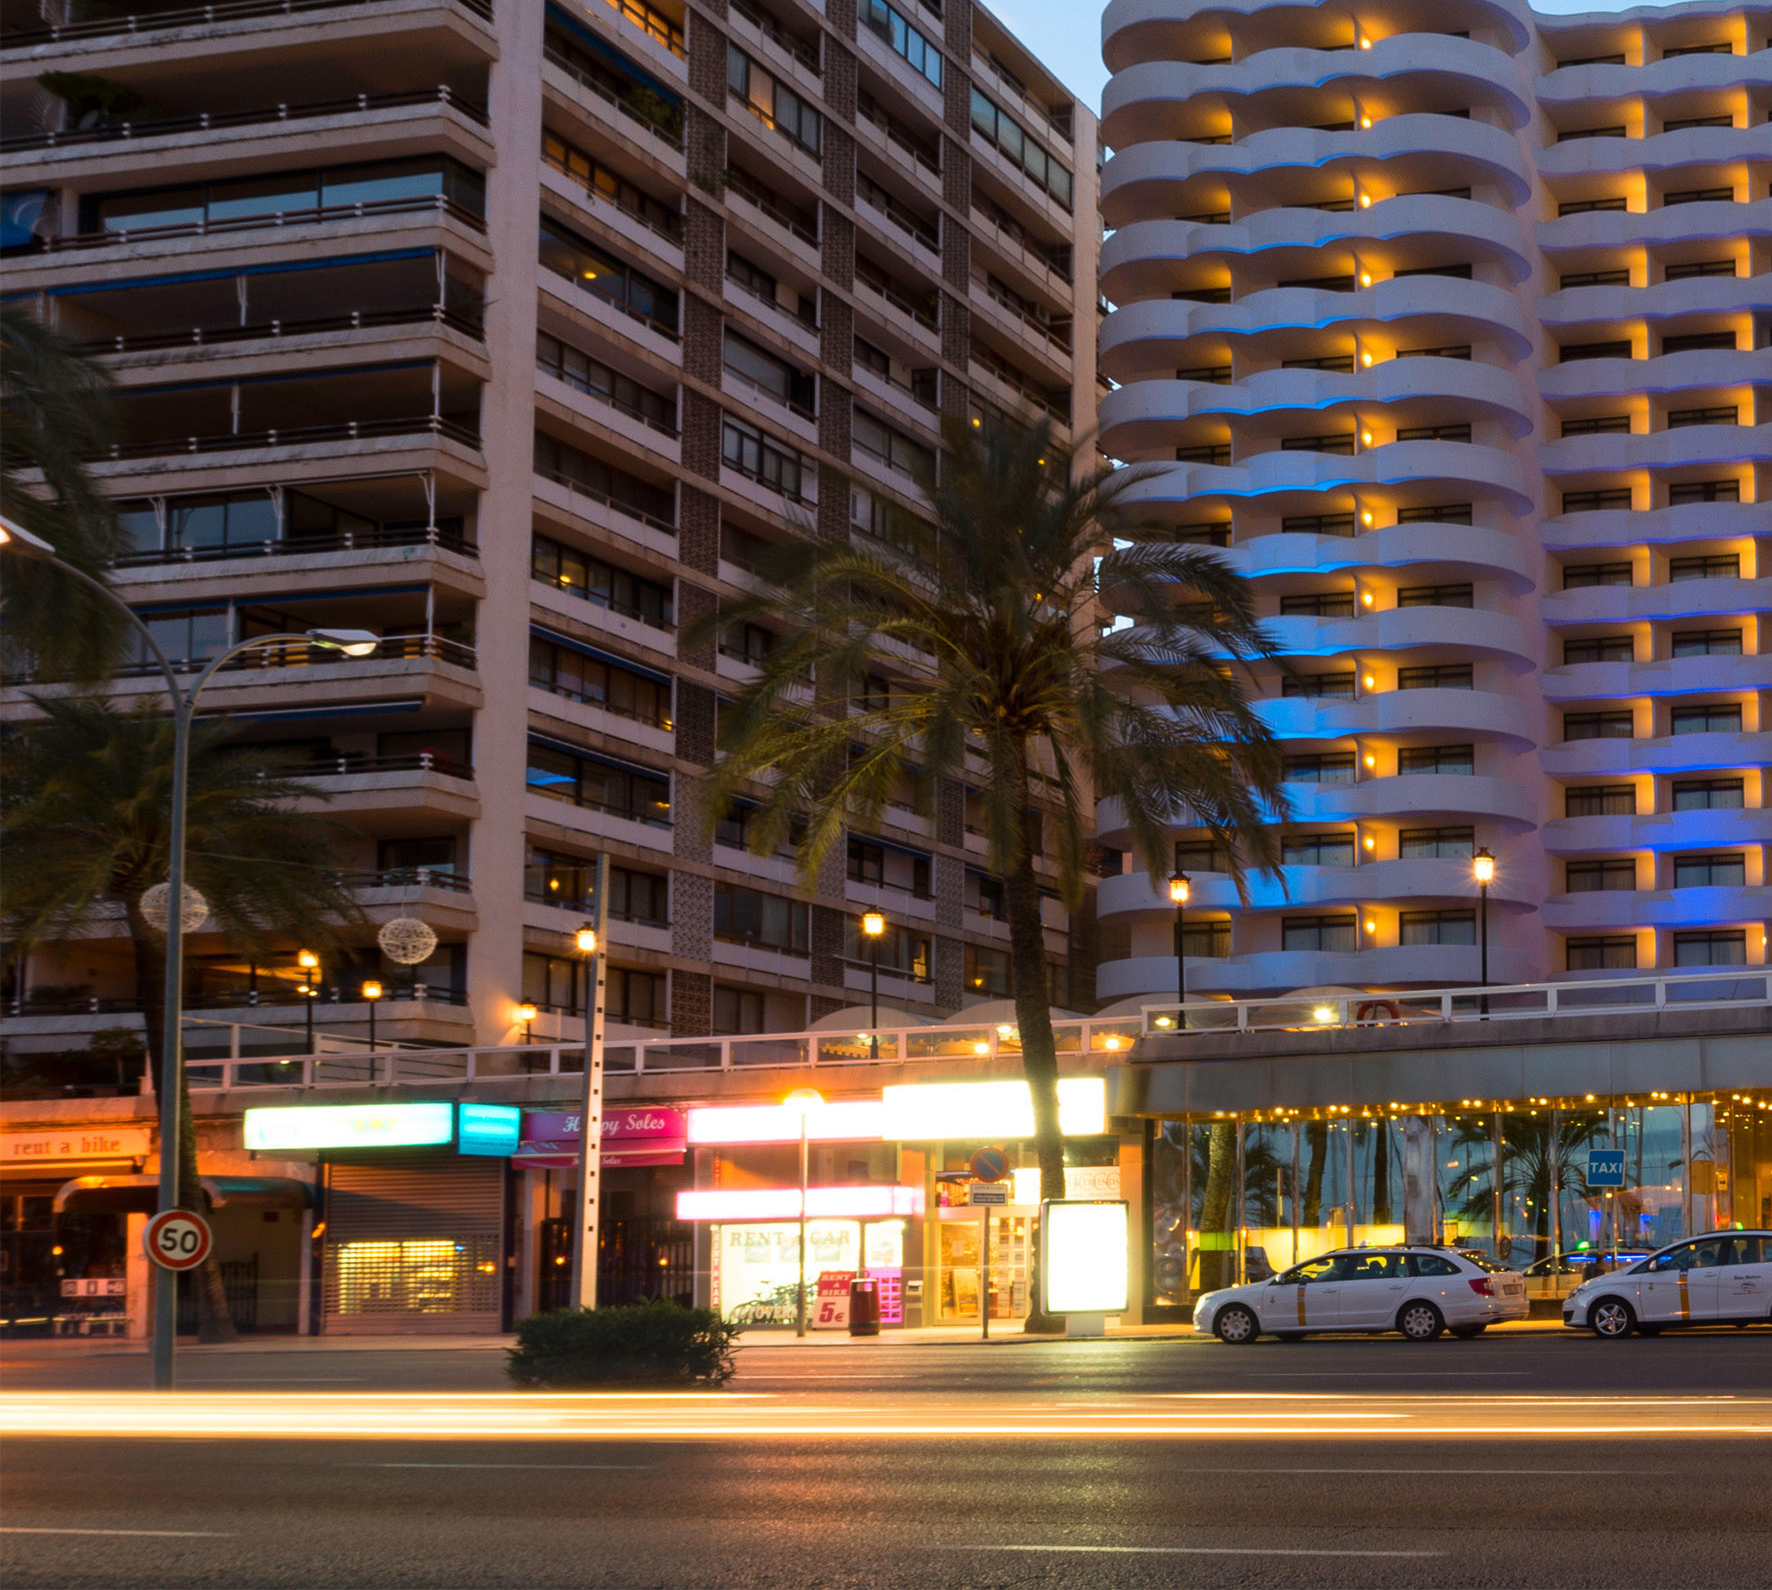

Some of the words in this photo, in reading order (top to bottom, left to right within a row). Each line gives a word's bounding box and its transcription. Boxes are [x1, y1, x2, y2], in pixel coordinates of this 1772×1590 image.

[625, 1113, 665, 1130] Soles
[14, 1141, 50, 1155] rent
[60, 1142, 71, 1154] a
[81, 1136, 121, 1153] bike
[1590, 1162, 1623, 1173] TAXI
[160, 1227, 199, 1254] 50
[729, 1231, 784, 1247] RENT
[809, 1230, 850, 1246] CAR
[821, 1274, 850, 1282] RENT
[821, 1289, 848, 1297] BIKE
